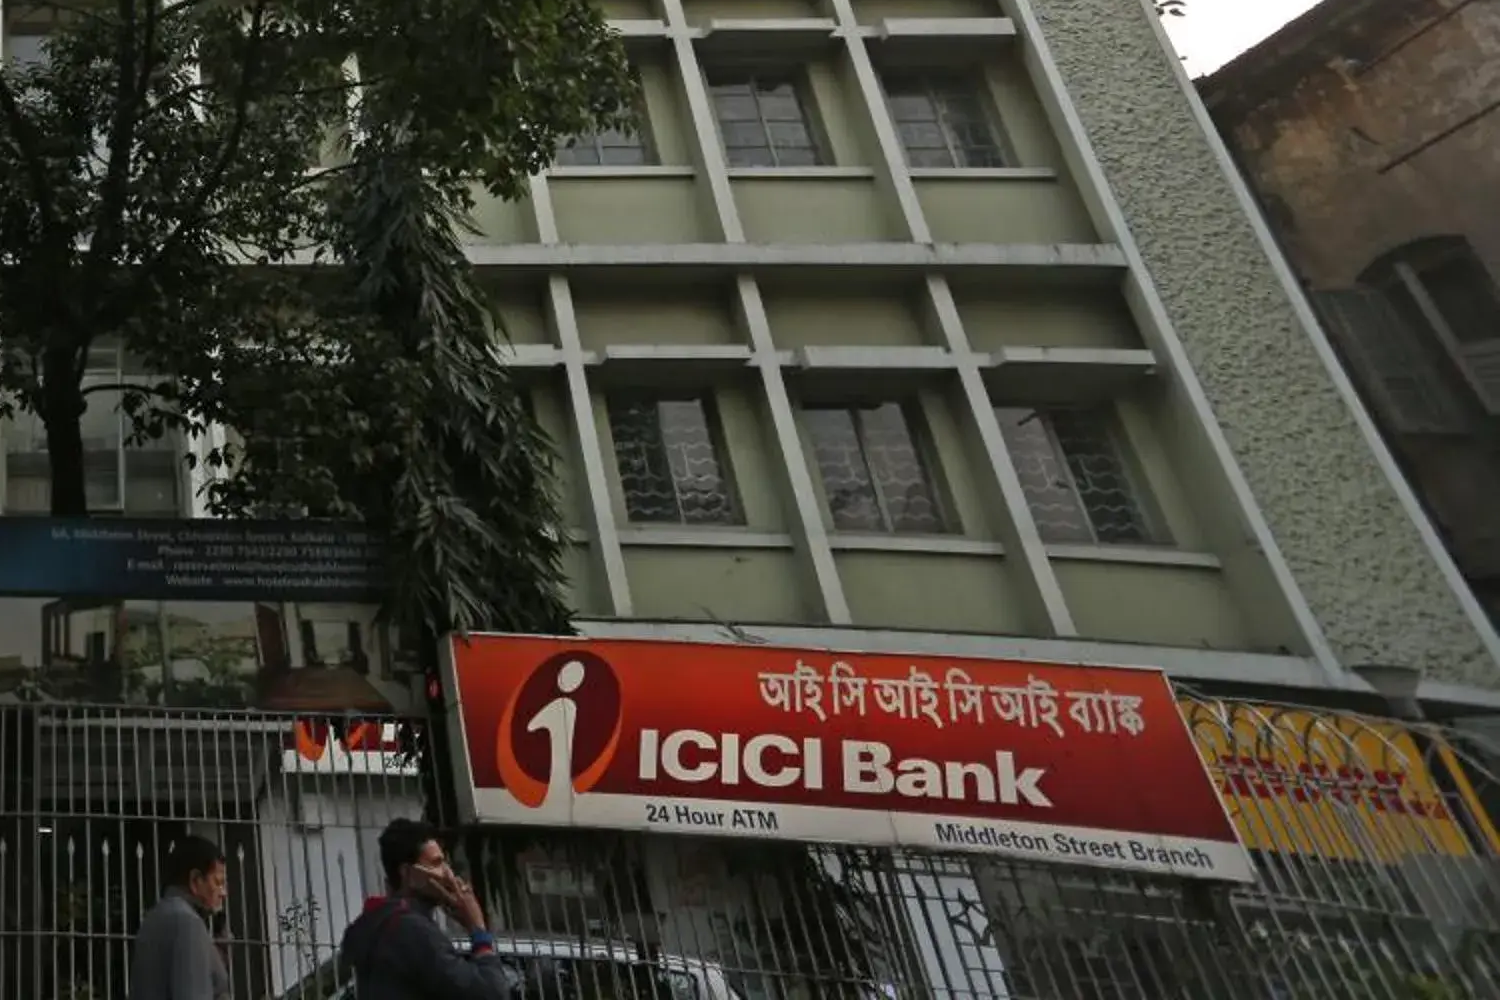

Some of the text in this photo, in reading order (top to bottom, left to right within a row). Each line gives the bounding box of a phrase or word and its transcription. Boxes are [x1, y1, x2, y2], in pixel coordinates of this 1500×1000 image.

[757, 659, 827, 722] আই
[828, 661, 868, 716] সি
[871, 665, 944, 728] আই
[943, 667, 985, 723] সি
[988, 672, 1065, 738] আই
[639, 728, 1053, 808] ICICI Bank
[646, 804, 779, 831] 24 Hour ATM
[935, 823, 1215, 870] Middleton Street Branch
